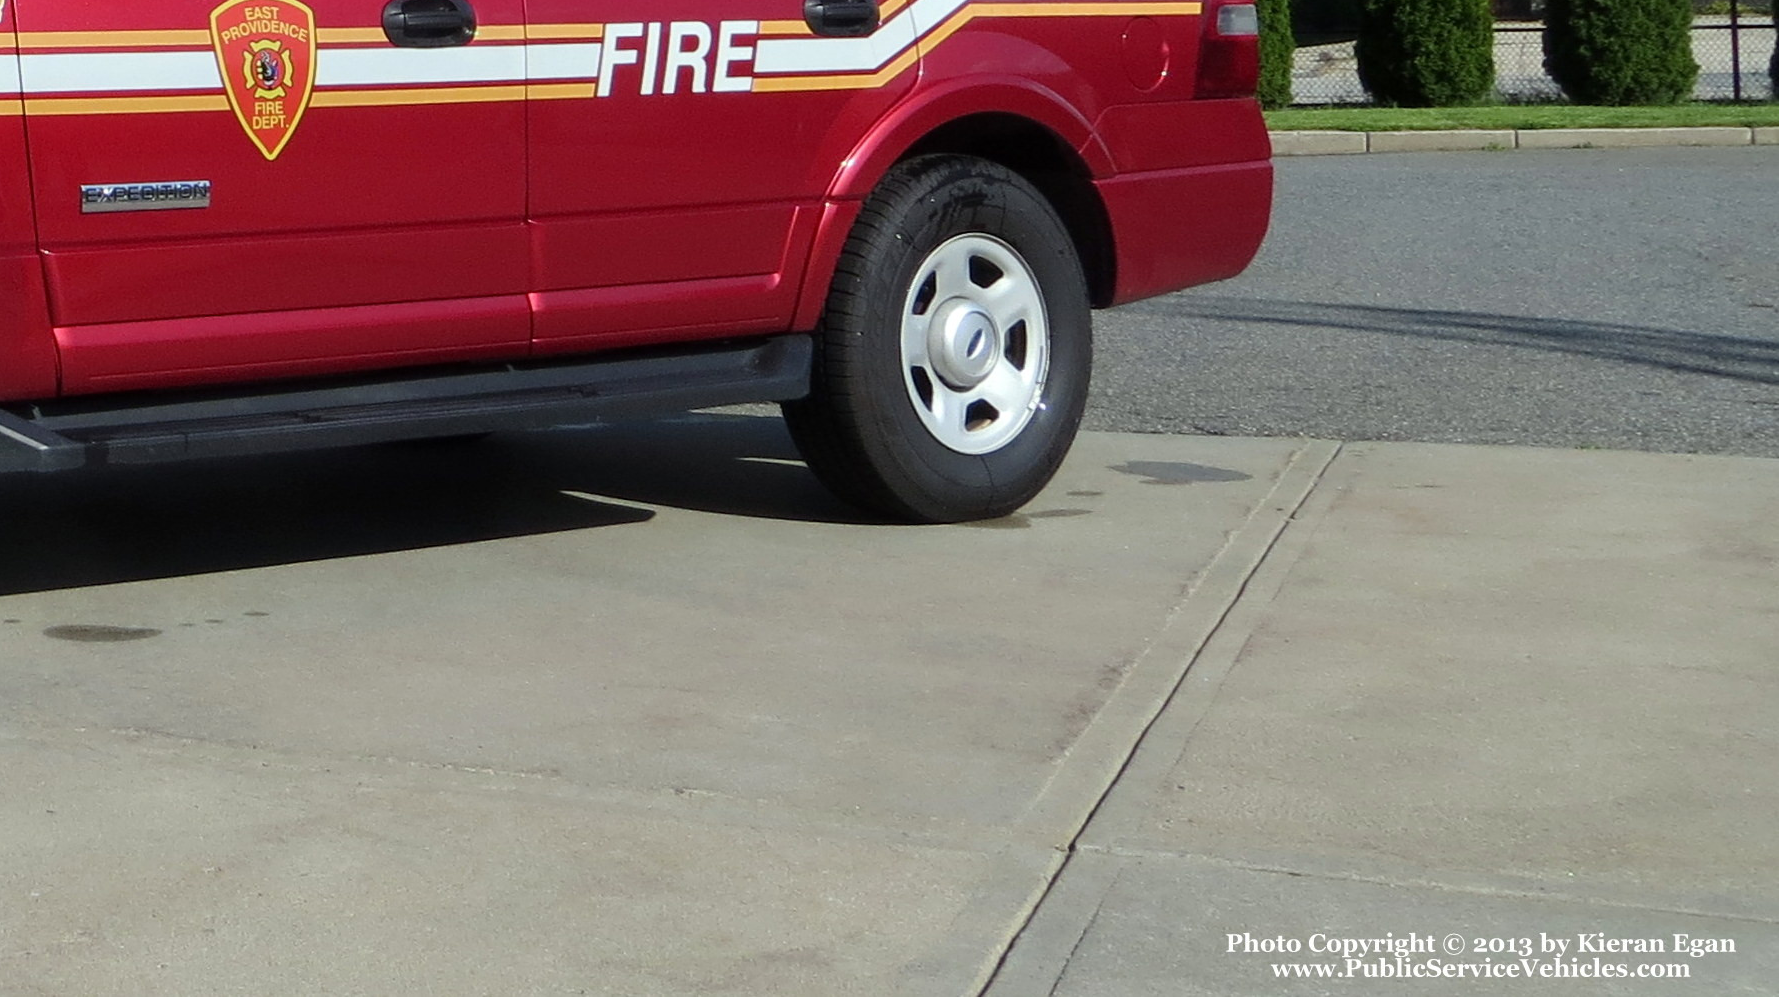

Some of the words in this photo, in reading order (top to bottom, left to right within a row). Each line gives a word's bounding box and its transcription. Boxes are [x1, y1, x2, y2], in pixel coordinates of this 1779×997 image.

[244, 6, 280, 22] EAST
[221, 20, 309, 45] PROVIDENCE
[597, 20, 758, 97] FIRE
[254, 102, 284, 115] FIRE
[252, 115, 289, 130] DEPT.
[85, 182, 208, 203] EXPEDITION
